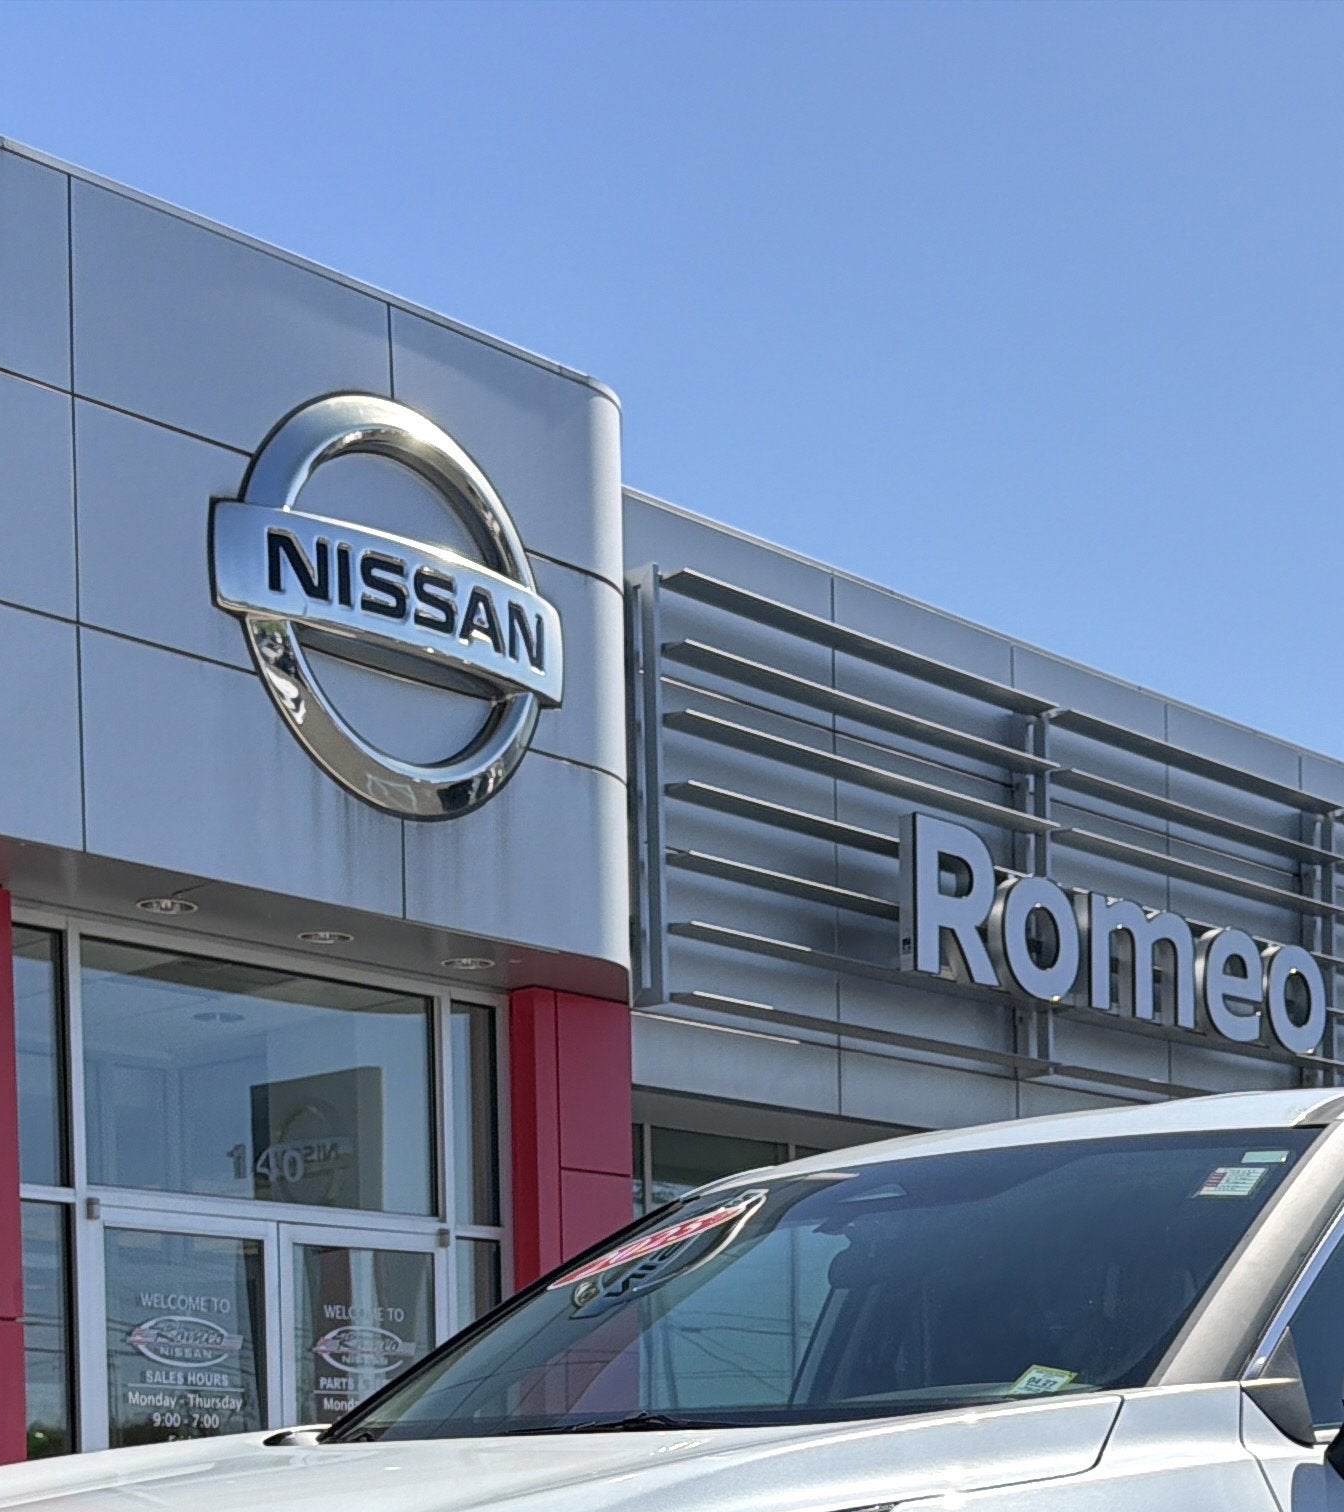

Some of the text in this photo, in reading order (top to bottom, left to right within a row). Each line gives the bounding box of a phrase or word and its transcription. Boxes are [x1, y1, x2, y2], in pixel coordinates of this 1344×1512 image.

[267, 528, 545, 675] NISSAN
[910, 811, 1327, 1056] Romeo
[227, 1144, 305, 1183] 140
[140, 1291, 231, 1313] WELCOME TO
[387, 1307, 405, 1322] TO
[145, 1370, 229, 1387] SALES HOURS
[319, 1377, 354, 1390] PARTS
[128, 1391, 177, 1409] Monday
[187, 1393, 243, 1412] Thursday
[152, 1412, 181, 1428] 9:00
[192, 1413, 220, 1429] 7:00
